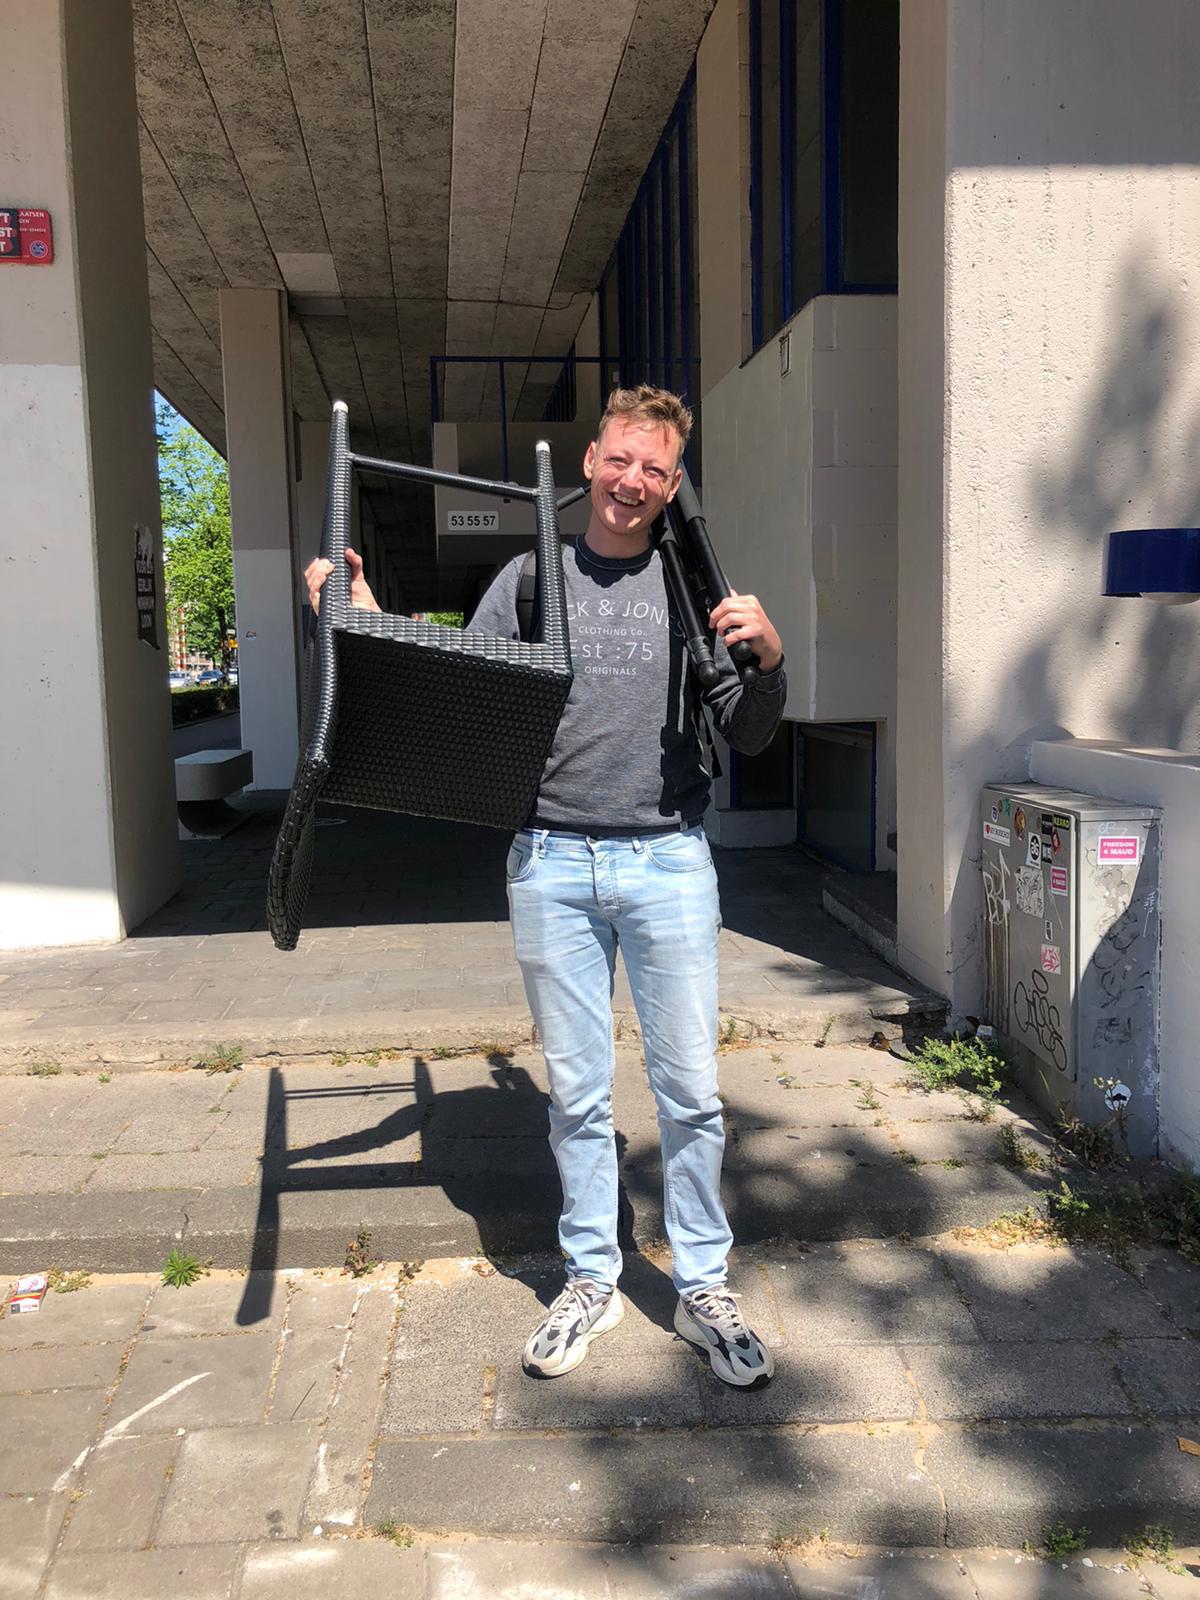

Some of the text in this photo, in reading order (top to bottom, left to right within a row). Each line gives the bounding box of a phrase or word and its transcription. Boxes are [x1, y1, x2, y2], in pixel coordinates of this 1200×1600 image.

[451, 515, 496, 526] 53 55 57
[598, 599, 615, 617] &
[578, 625, 628, 637] CLOTHING
[584, 665, 637, 676] ORIGINALS
[1110, 847, 1134, 855] MAUD
